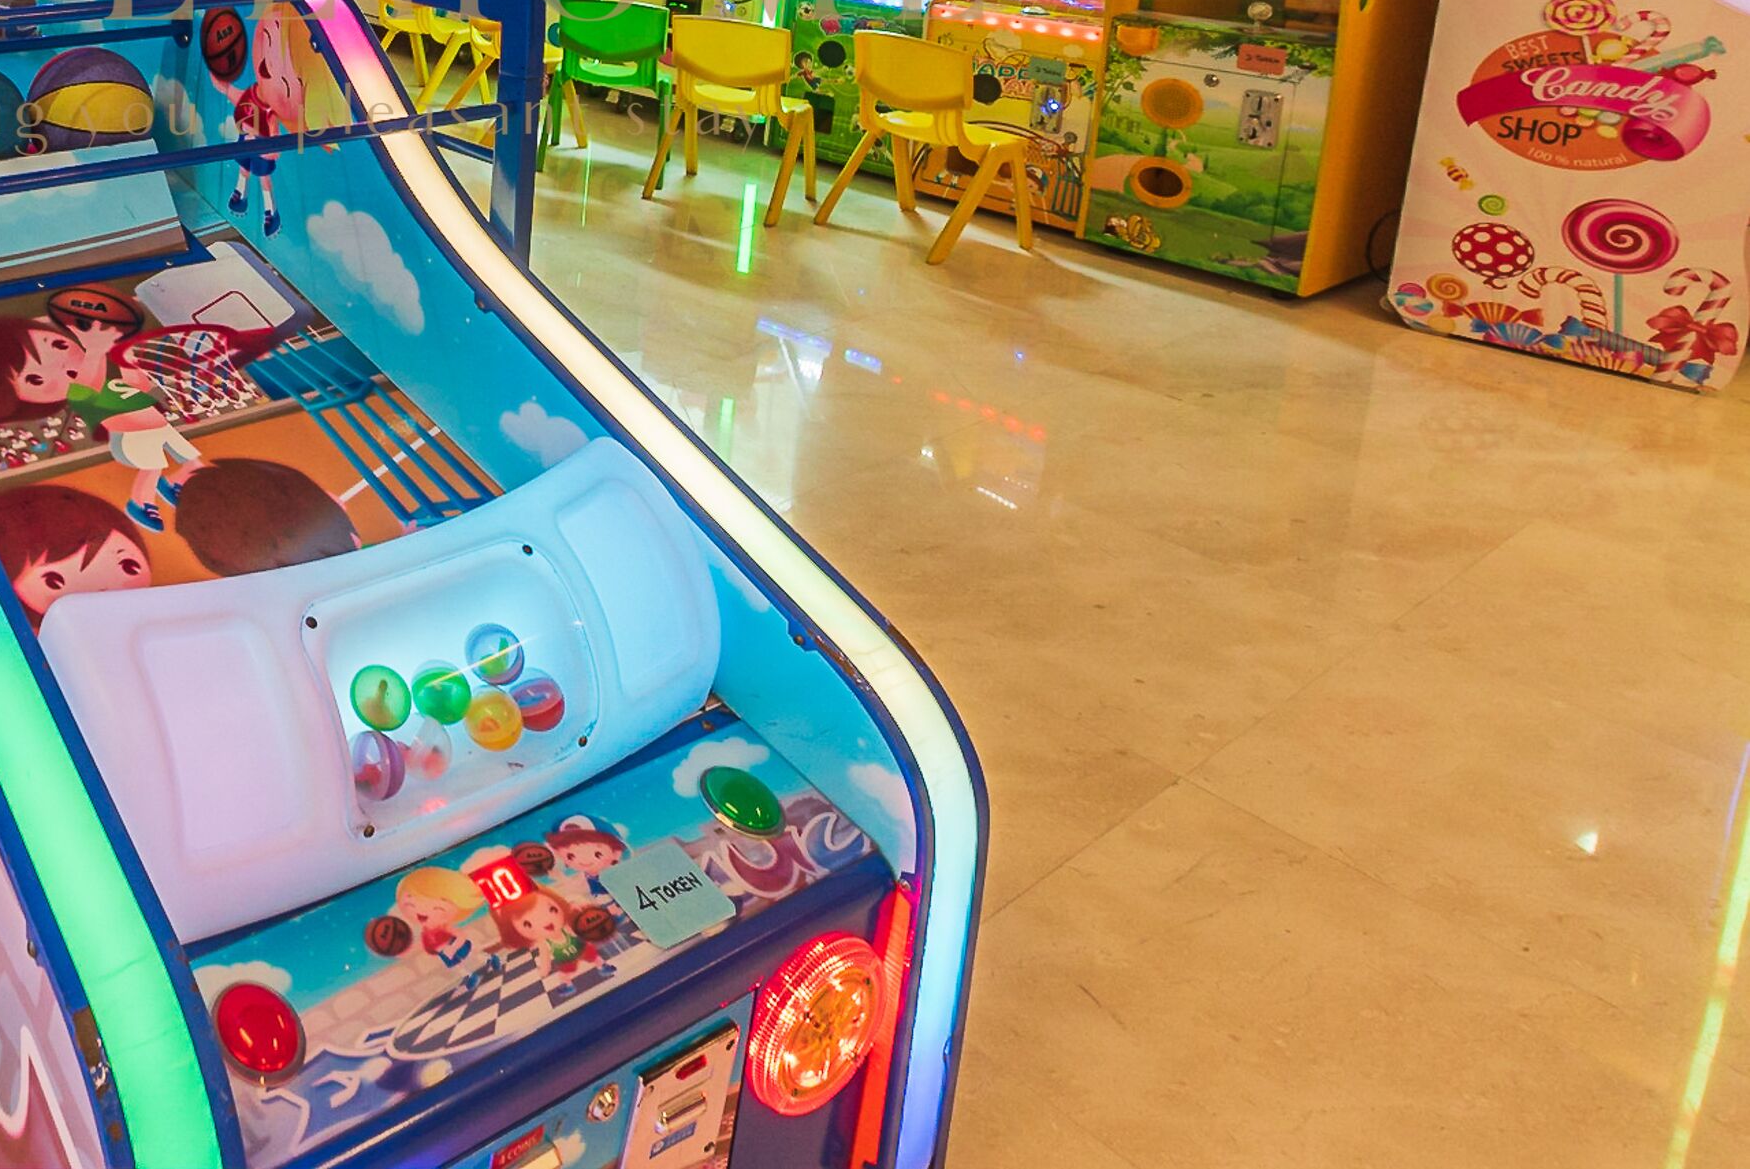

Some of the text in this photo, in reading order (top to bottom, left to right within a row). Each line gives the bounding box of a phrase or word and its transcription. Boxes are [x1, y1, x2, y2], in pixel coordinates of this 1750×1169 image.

[1504, 35, 1550, 59] BEST
[1501, 50, 1584, 73] SWEETS
[1519, 66, 1679, 121] Candy
[1496, 115, 1583, 146] SHOP
[1573, 152, 1629, 169] natural
[635, 872, 703, 912] 4 TOKEN
